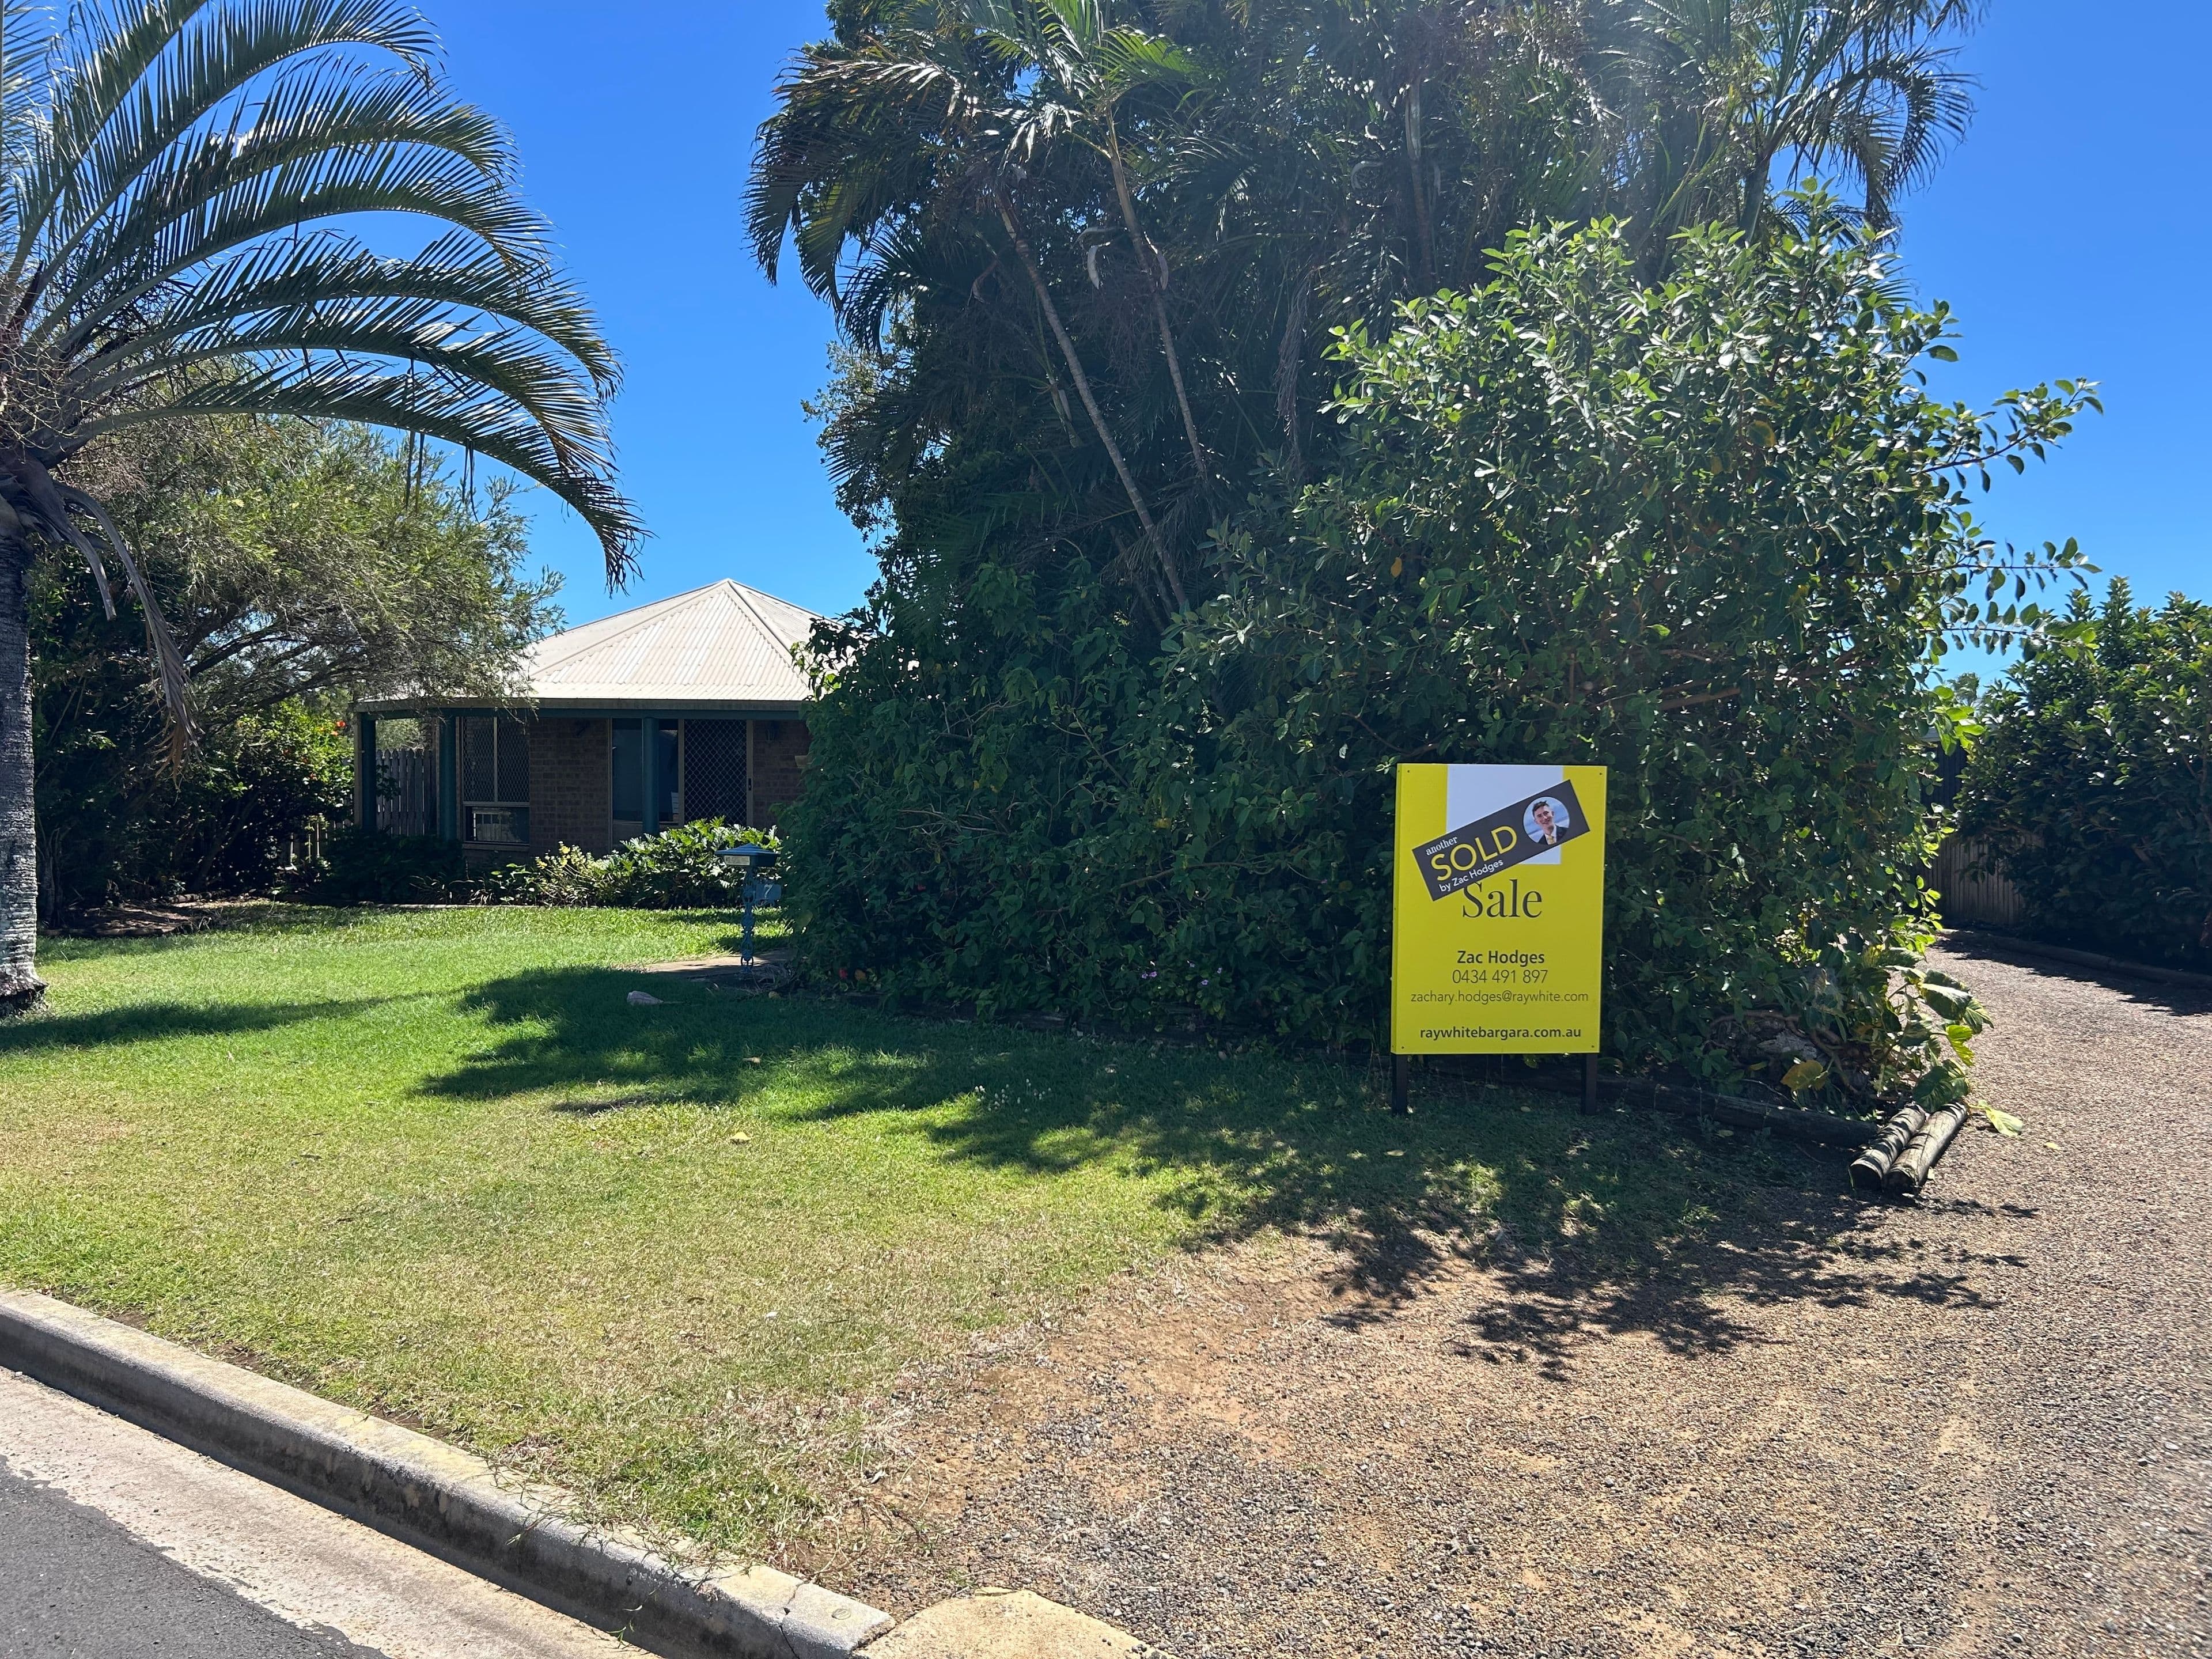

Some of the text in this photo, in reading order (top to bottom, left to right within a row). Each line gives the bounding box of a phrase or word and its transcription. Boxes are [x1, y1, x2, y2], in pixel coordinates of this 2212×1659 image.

[1426, 836, 1459, 856] another
[1431, 825, 1518, 881] SOLD
[1439, 859, 1504, 892] by Zac Hodges
[764, 884, 773, 899] 7
[1462, 878, 1543, 918] Sale
[1457, 950, 1545, 967] Zac Hodges
[1452, 969, 1548, 984] 0434 491 897
[1410, 990, 1589, 1005] zachary.hodges@raywhite.com
[1420, 1026, 1581, 1041] raywhitebargara.com.au
